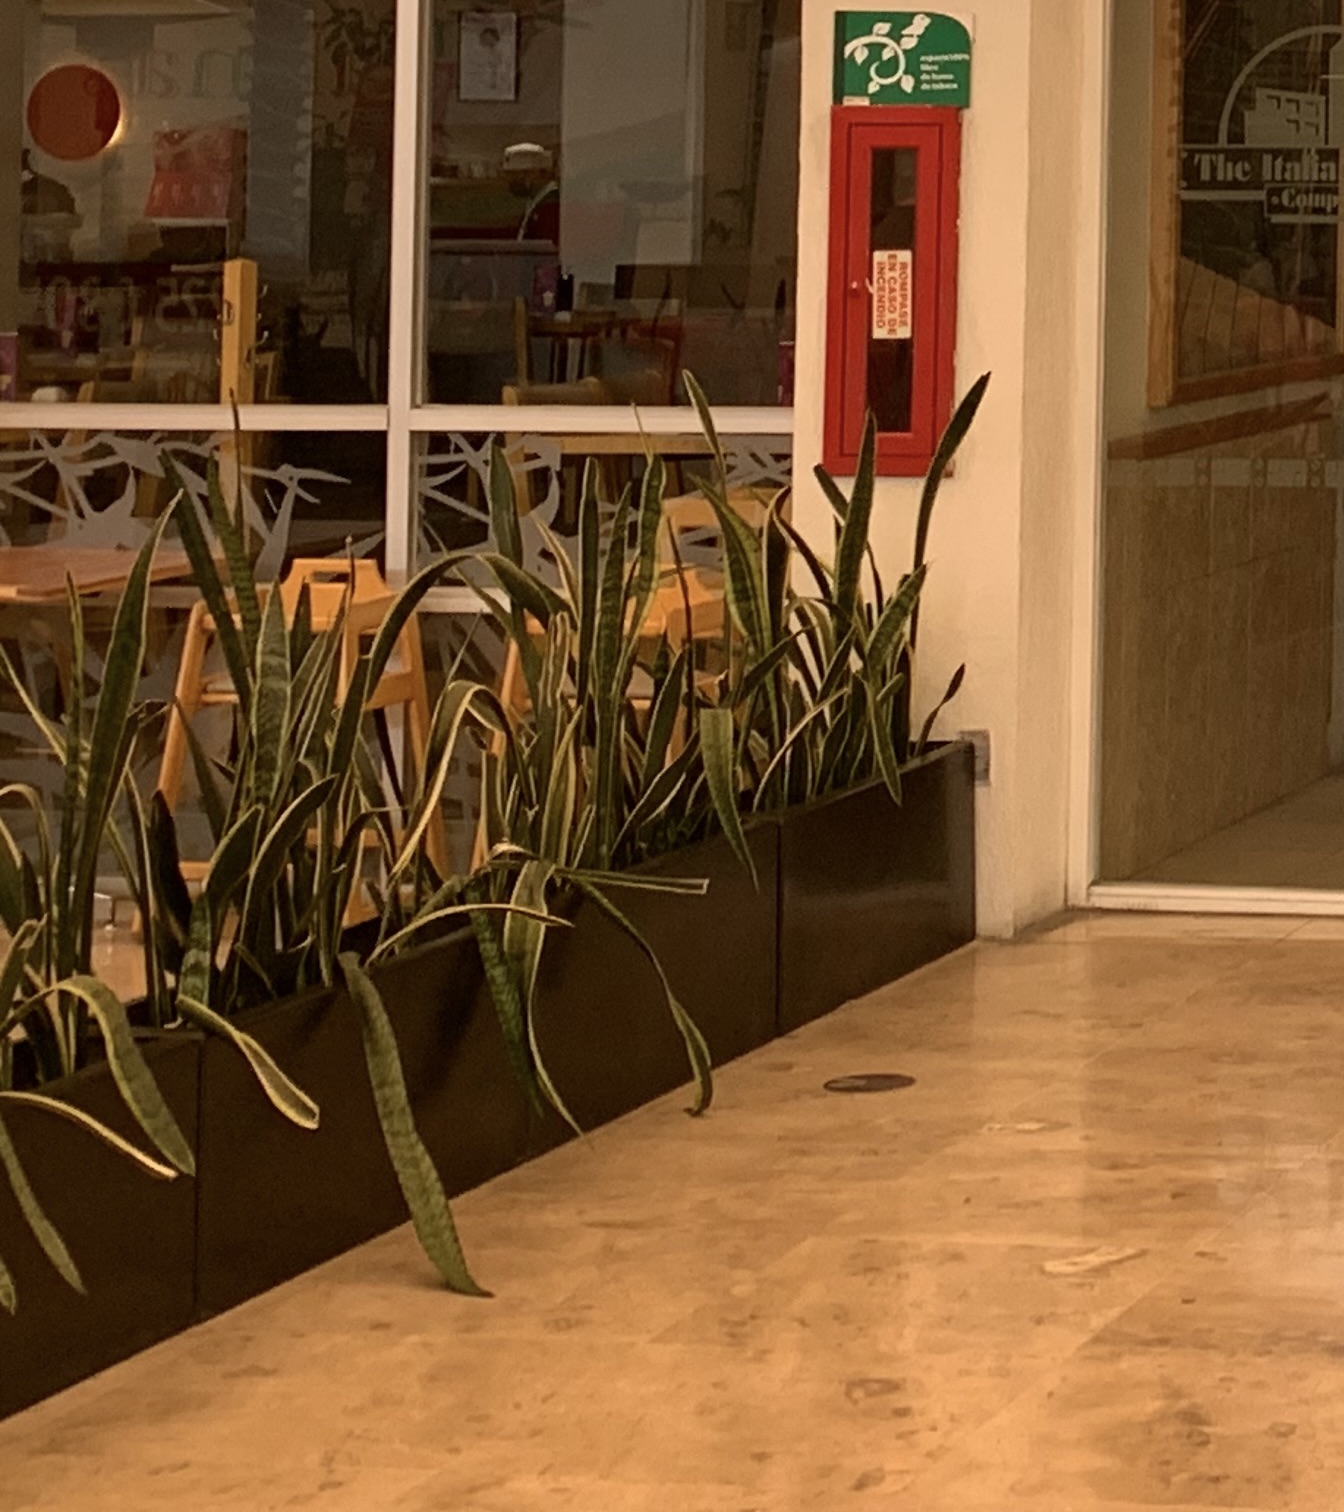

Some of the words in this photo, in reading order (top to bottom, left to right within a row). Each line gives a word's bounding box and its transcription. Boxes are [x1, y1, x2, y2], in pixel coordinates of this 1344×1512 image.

[1194, 152, 1251, 182] The
[887, 253, 897, 272] EN
[876, 261, 886, 329] INCENDIO
[887, 276, 897, 314] CASO
[899, 261, 909, 328] ROMPASE
[887, 318, 897, 336] DE
